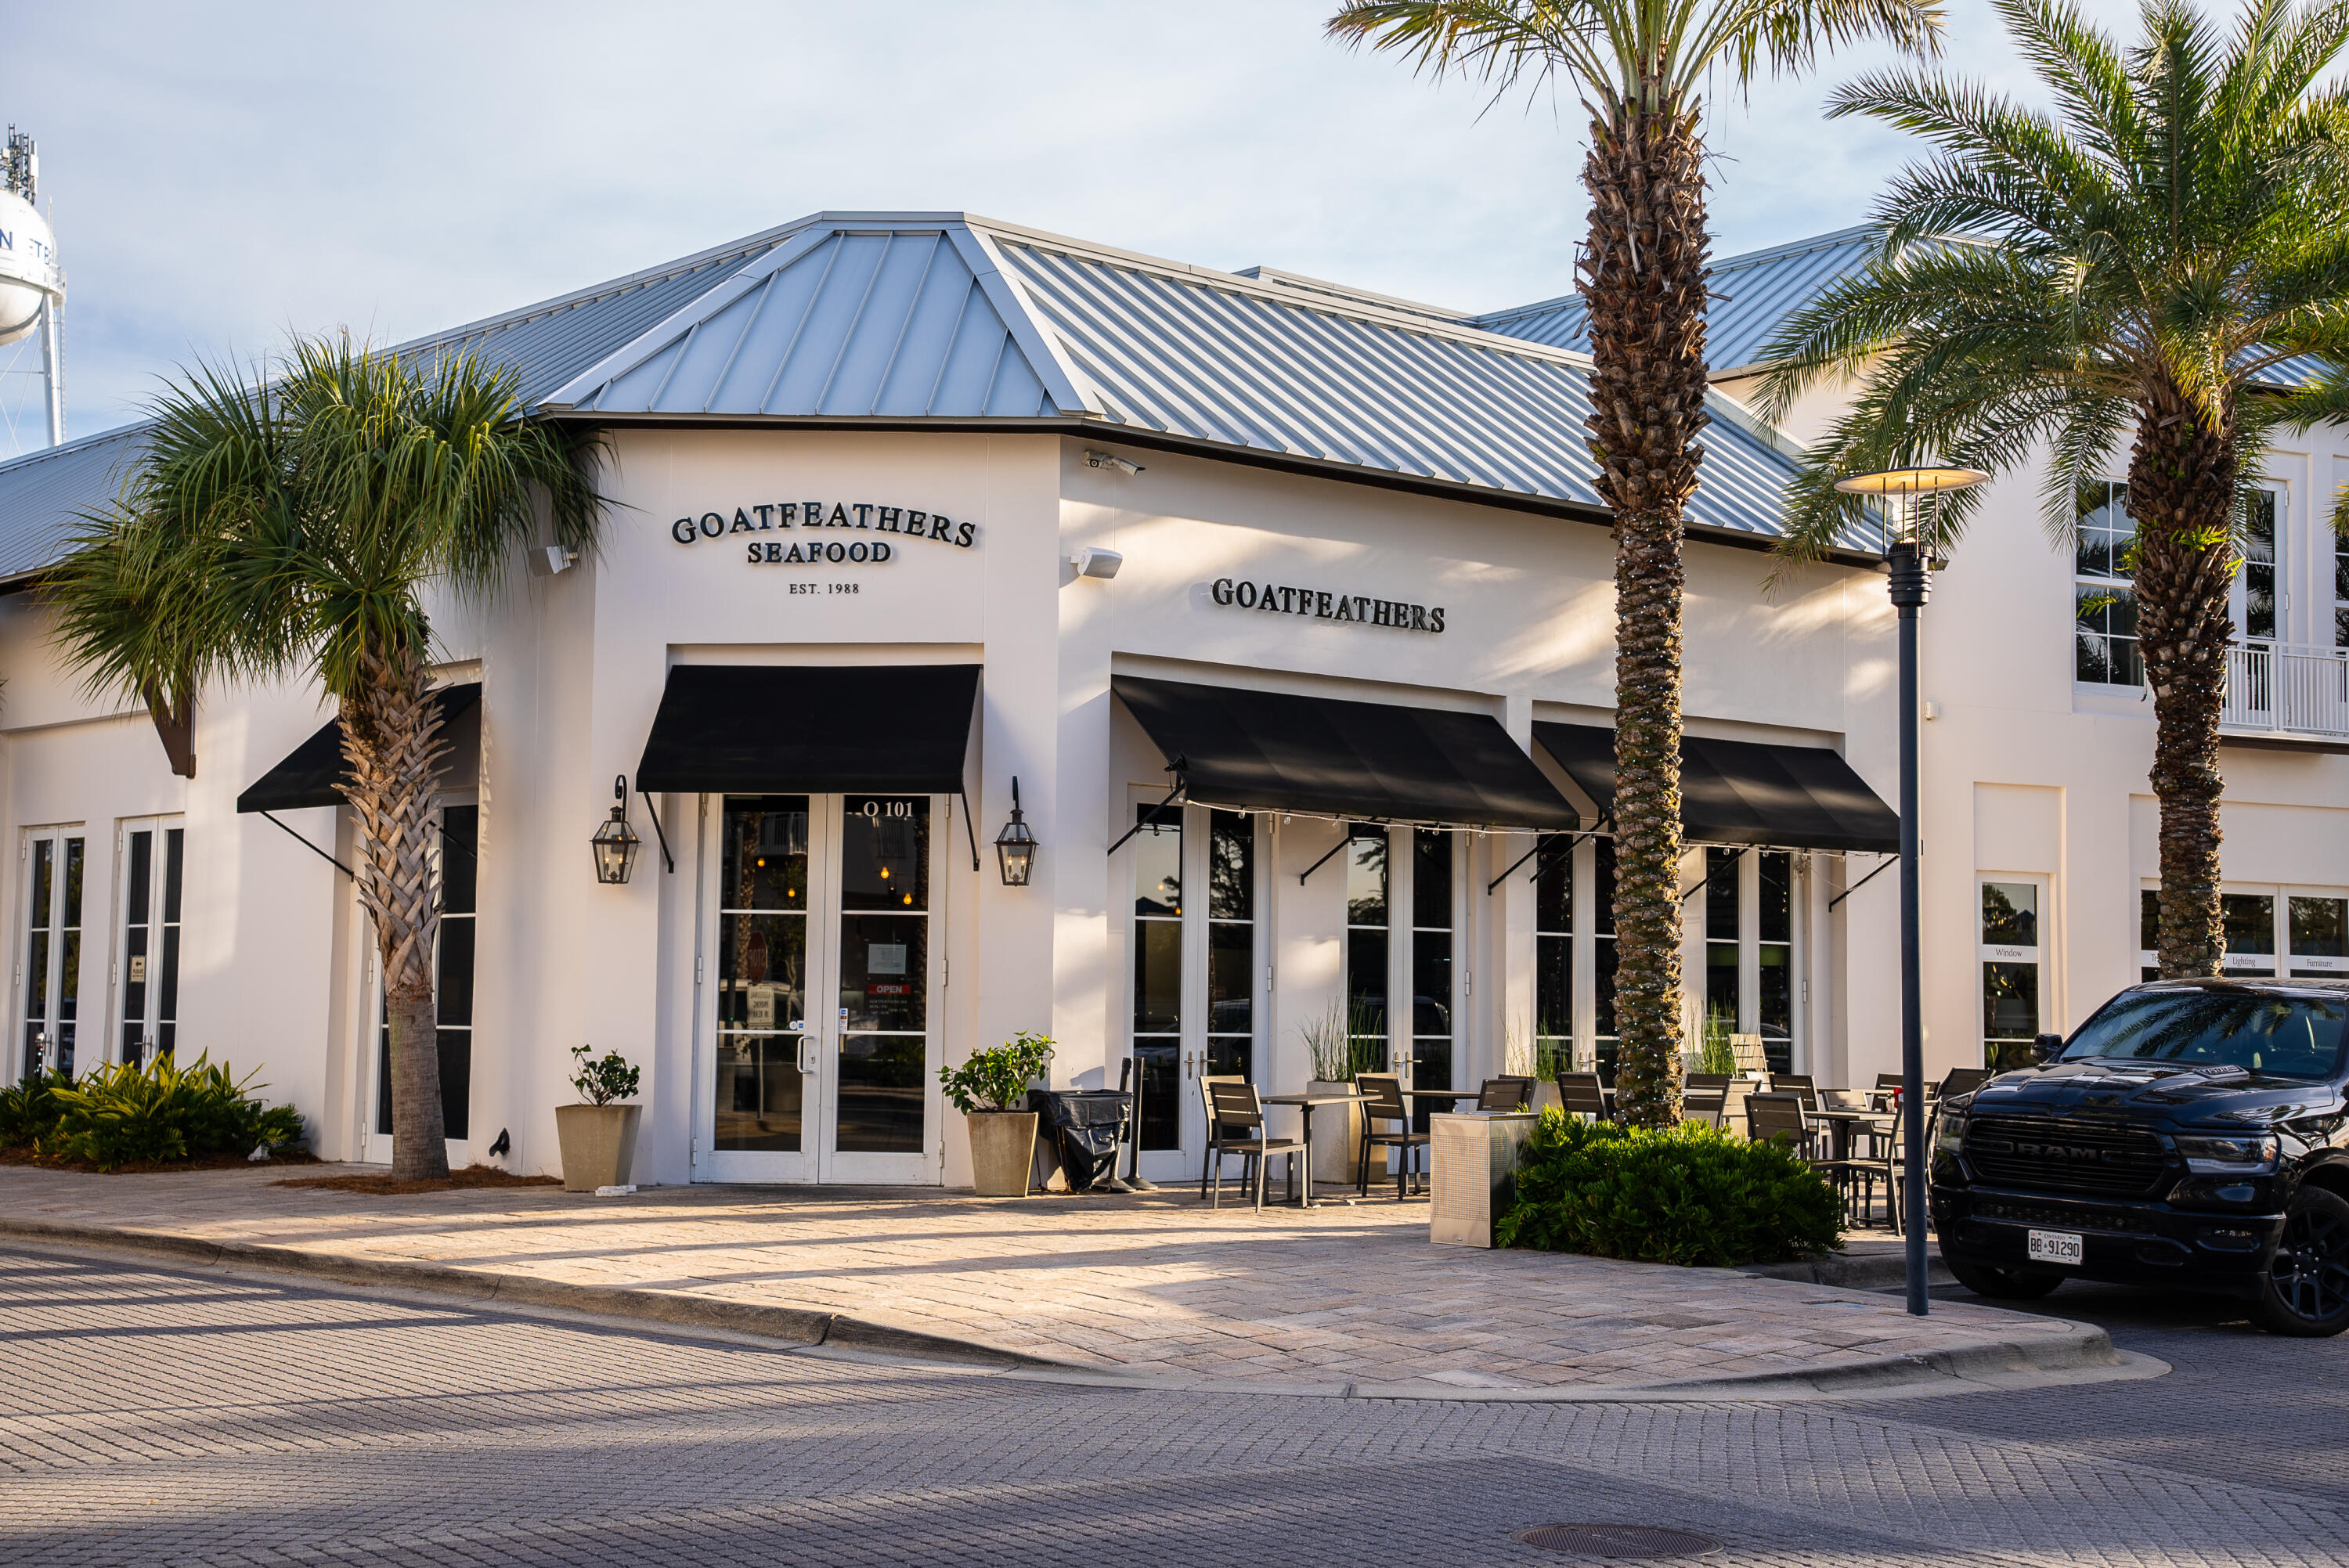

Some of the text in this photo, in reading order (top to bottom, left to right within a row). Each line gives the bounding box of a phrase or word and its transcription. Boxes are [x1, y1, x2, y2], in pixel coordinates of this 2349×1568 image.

[672, 502, 976, 548] GOATFEATHERS
[748, 542, 891, 564] SEAFOOD
[789, 583, 860, 594] EST. 1988
[1211, 578, 1445, 633] GOATFEATHERS
[864, 802, 913, 816] O 101
[1996, 948, 2022, 957] Window
[2232, 956, 2256, 968] Lighting
[2307, 958, 2333, 968] Furniture
[2017, 1143, 2097, 1159] RAM
[2048, 1239, 2080, 1257] 91290
